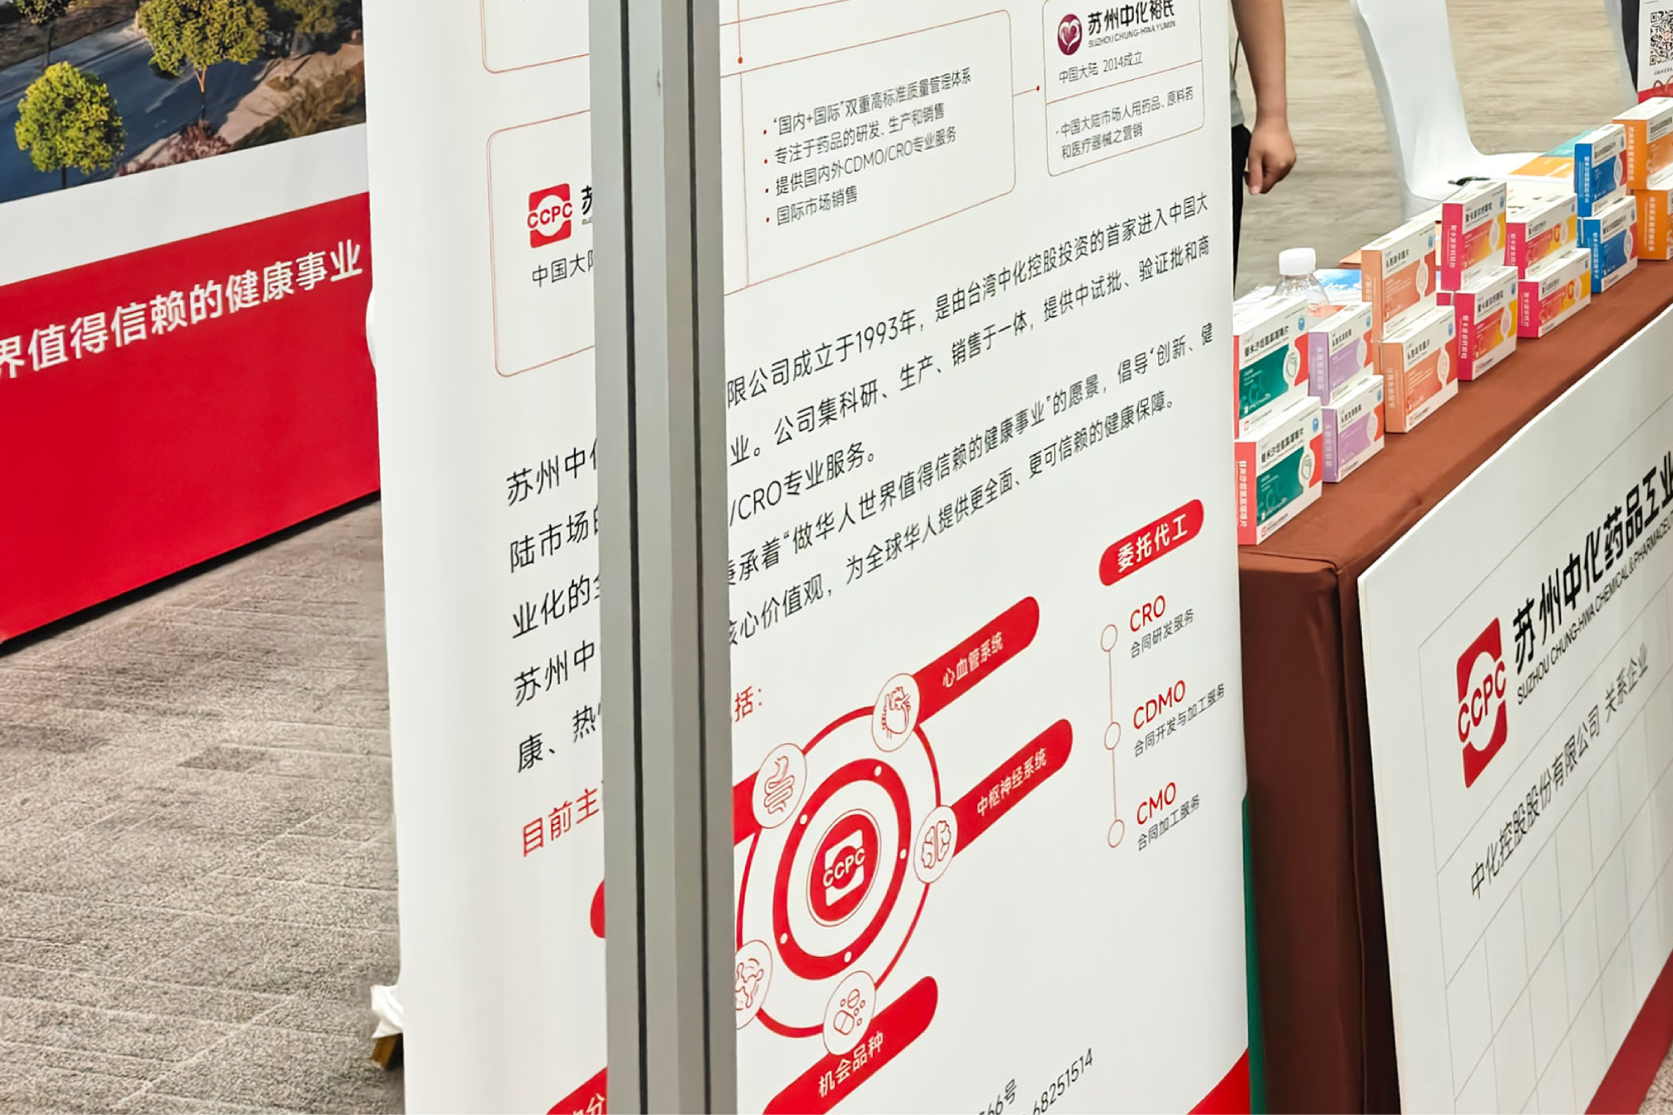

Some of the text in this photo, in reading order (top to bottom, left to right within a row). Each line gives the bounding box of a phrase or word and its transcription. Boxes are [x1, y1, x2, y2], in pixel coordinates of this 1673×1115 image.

[775, 102, 945, 166] 专注于药品的研发、生产和销售
[775, 126, 956, 197] 提供国内外CDMO/CRO专业服务
[527, 202, 573, 229] CCPC
[776, 185, 858, 226] 国际市场销售
[1117, 513, 1188, 573] 委托代工
[512, 574, 601, 639] 业化的
[1130, 594, 1166, 632] CRO
[1130, 607, 1194, 659] 合同研发服务
[514, 639, 596, 707] 苏州中
[942, 631, 1004, 689] 心血管系统
[1517, 651, 1550, 706] SUZHOU
[1550, 602, 1595, 665] CHUNG-HWA
[1133, 679, 1186, 730] CDMO
[1133, 682, 1226, 759] 合同开发与加工服务
[1457, 658, 1507, 744] CCPC
[518, 702, 602, 774] 康、热
[1470, 640, 1650, 900] 中化控股股份有限公司 关系企业
[976, 747, 1047, 818] 中枢神经系统
[1136, 781, 1177, 826] CMO
[523, 787, 599, 857] 目前主
[1137, 793, 1201, 852] 合同加工服务
[823, 847, 866, 887] CCPC
[818, 1031, 885, 1098] 机会品种
